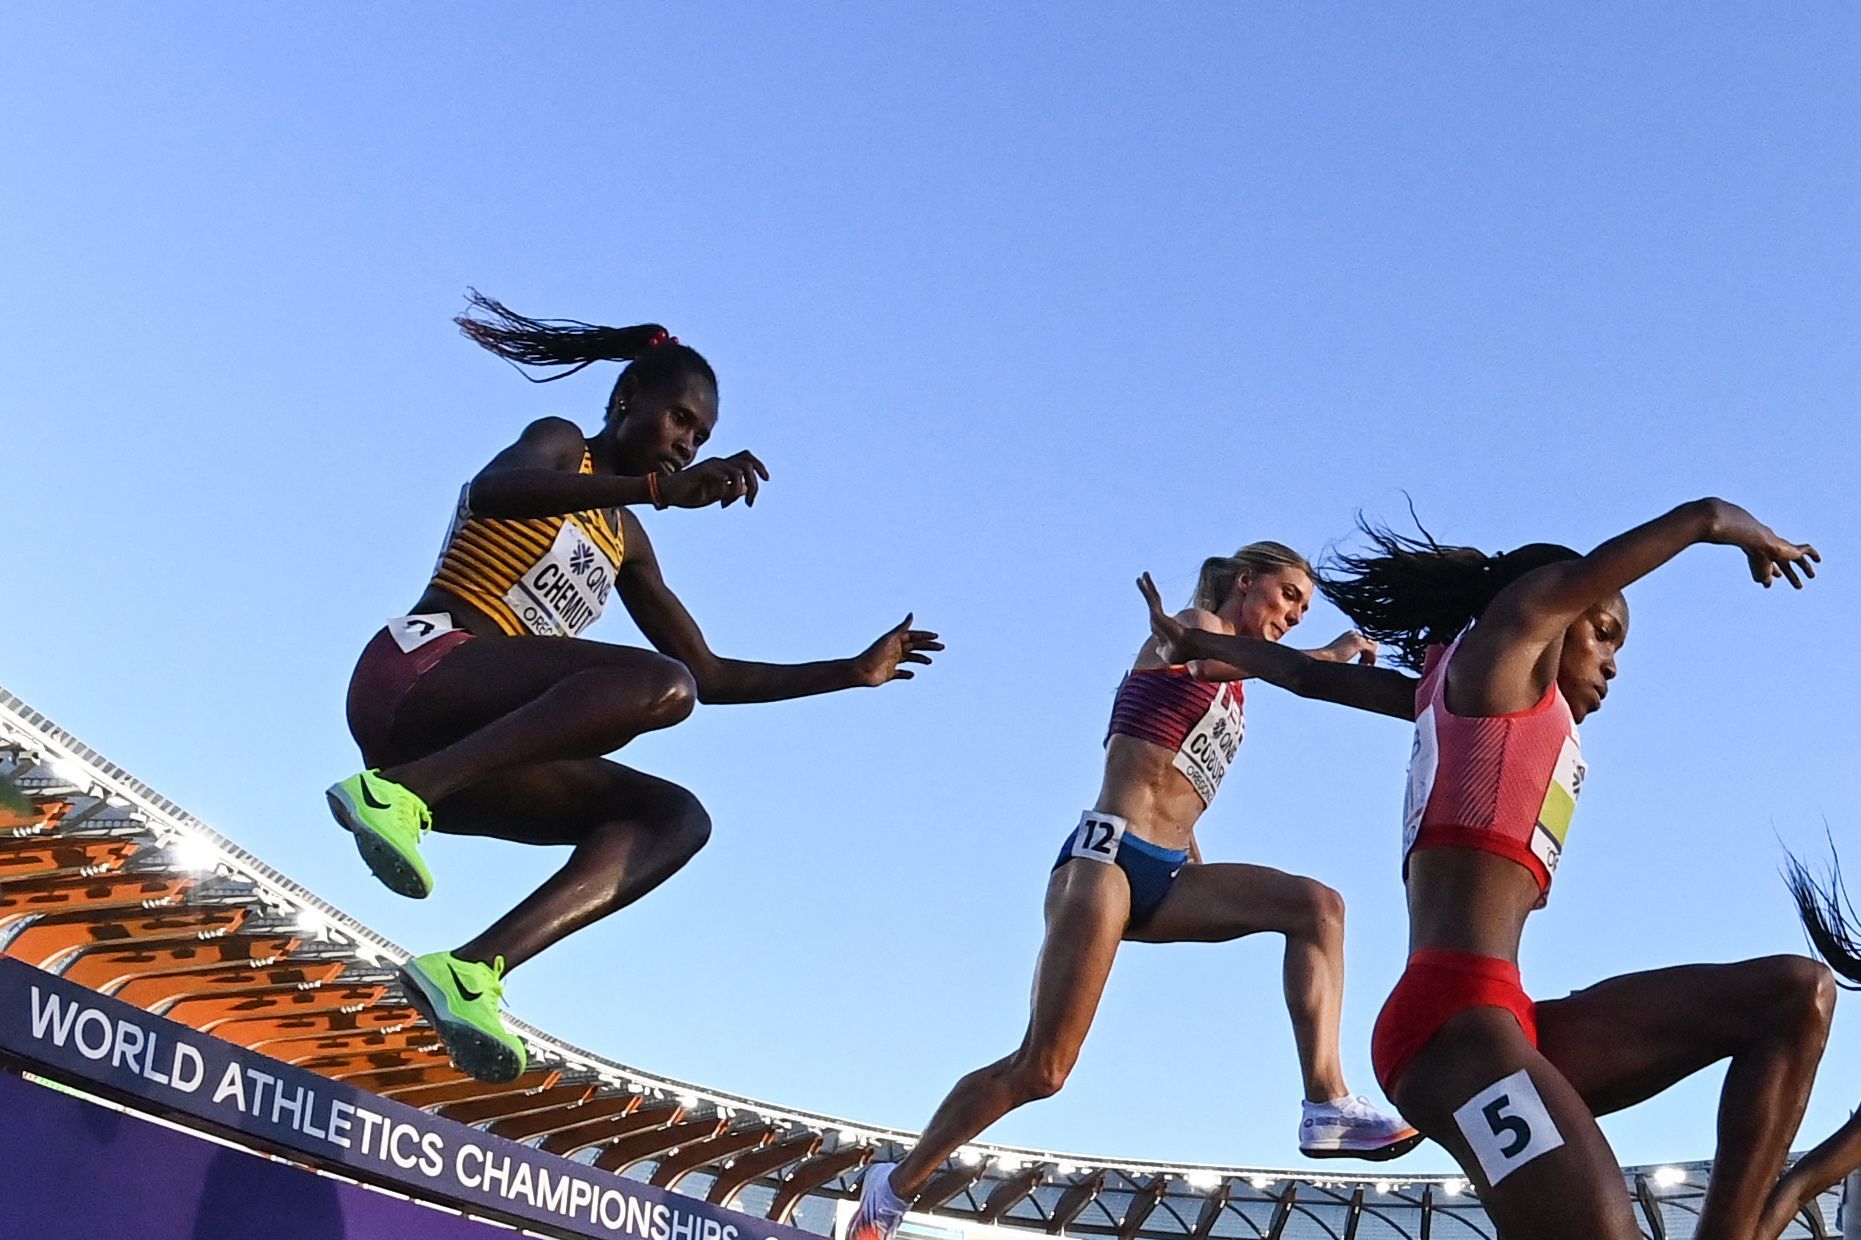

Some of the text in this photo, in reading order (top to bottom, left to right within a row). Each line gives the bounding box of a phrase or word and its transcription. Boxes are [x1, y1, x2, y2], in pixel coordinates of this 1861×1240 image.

[1082, 820, 1115, 854] 12
[30, 986, 204, 1094] WORLD
[211, 1061, 444, 1177] ATHLETICS
[1482, 1094, 1531, 1158] 5
